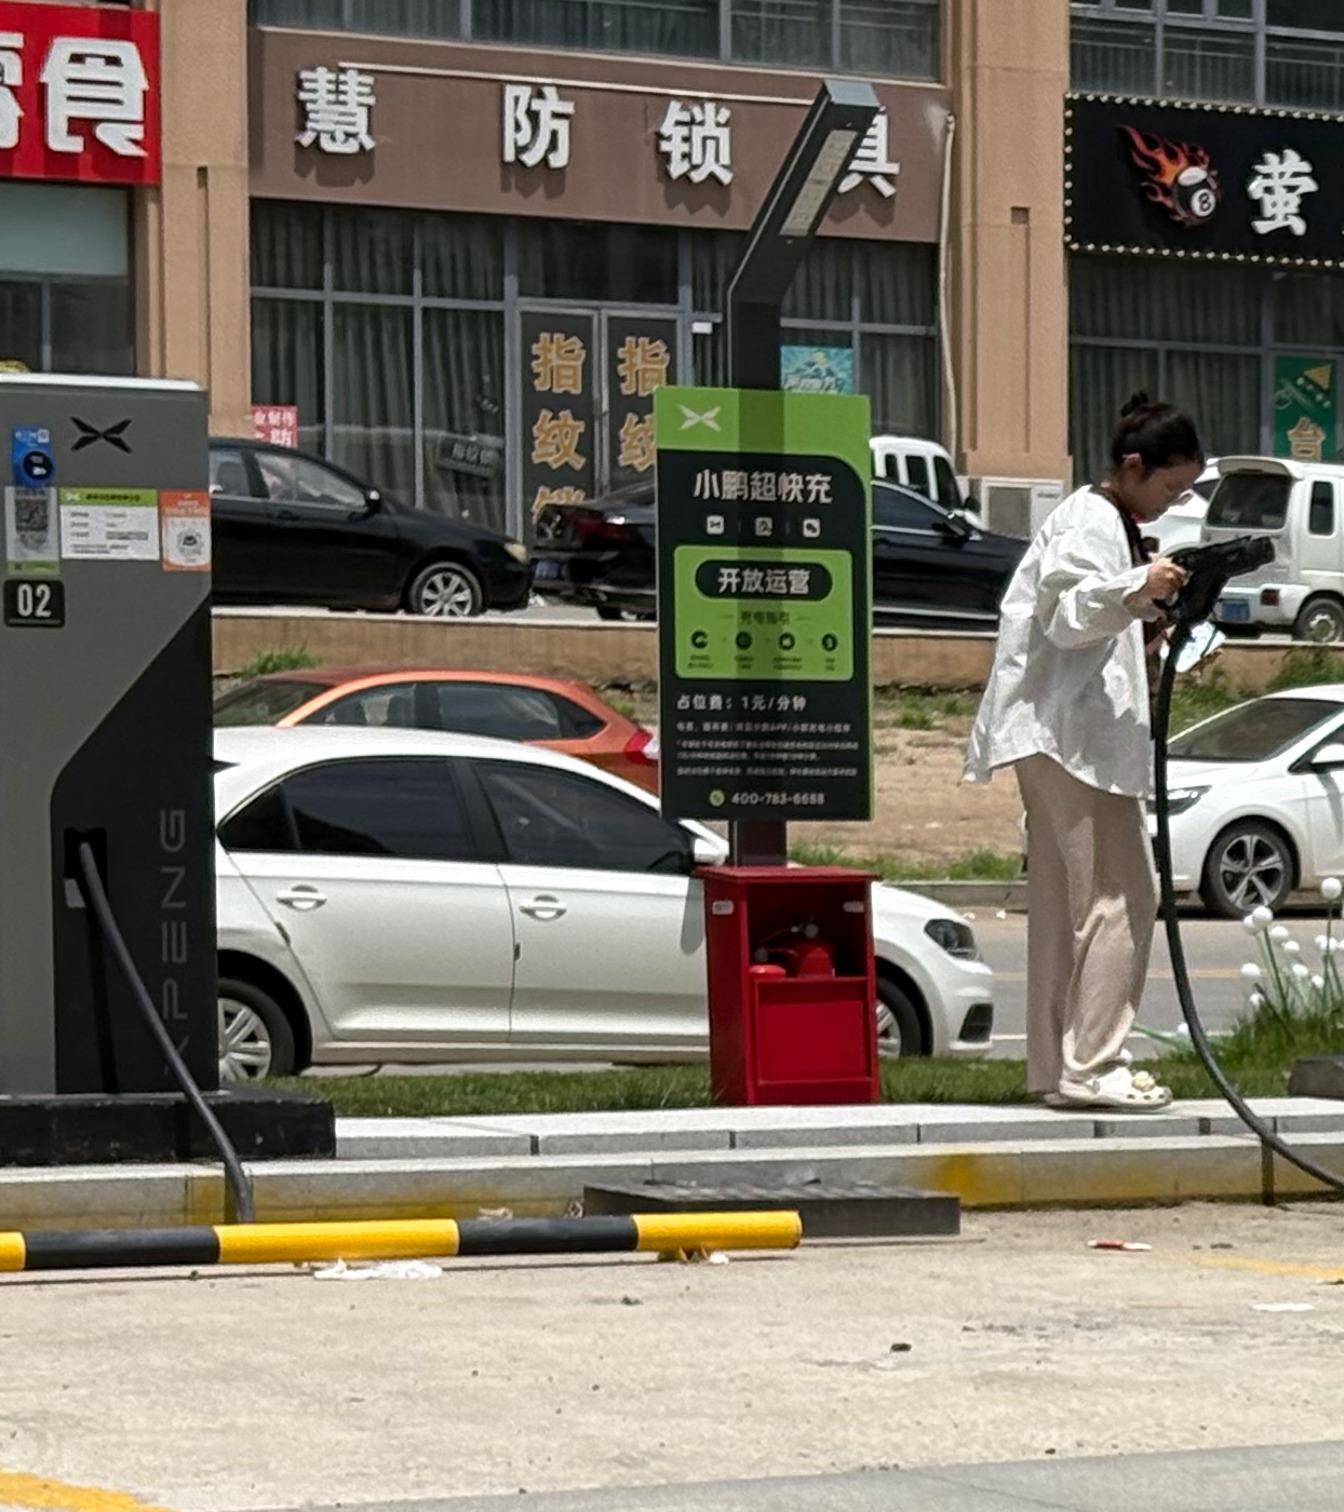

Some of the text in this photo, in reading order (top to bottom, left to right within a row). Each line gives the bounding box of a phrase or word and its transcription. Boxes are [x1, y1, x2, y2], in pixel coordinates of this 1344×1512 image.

[0, 30, 150, 157] 食
[693, 469, 833, 504] 小鹏超快充
[718, 567, 811, 596] 开放运营
[16, 583, 53, 618] 02
